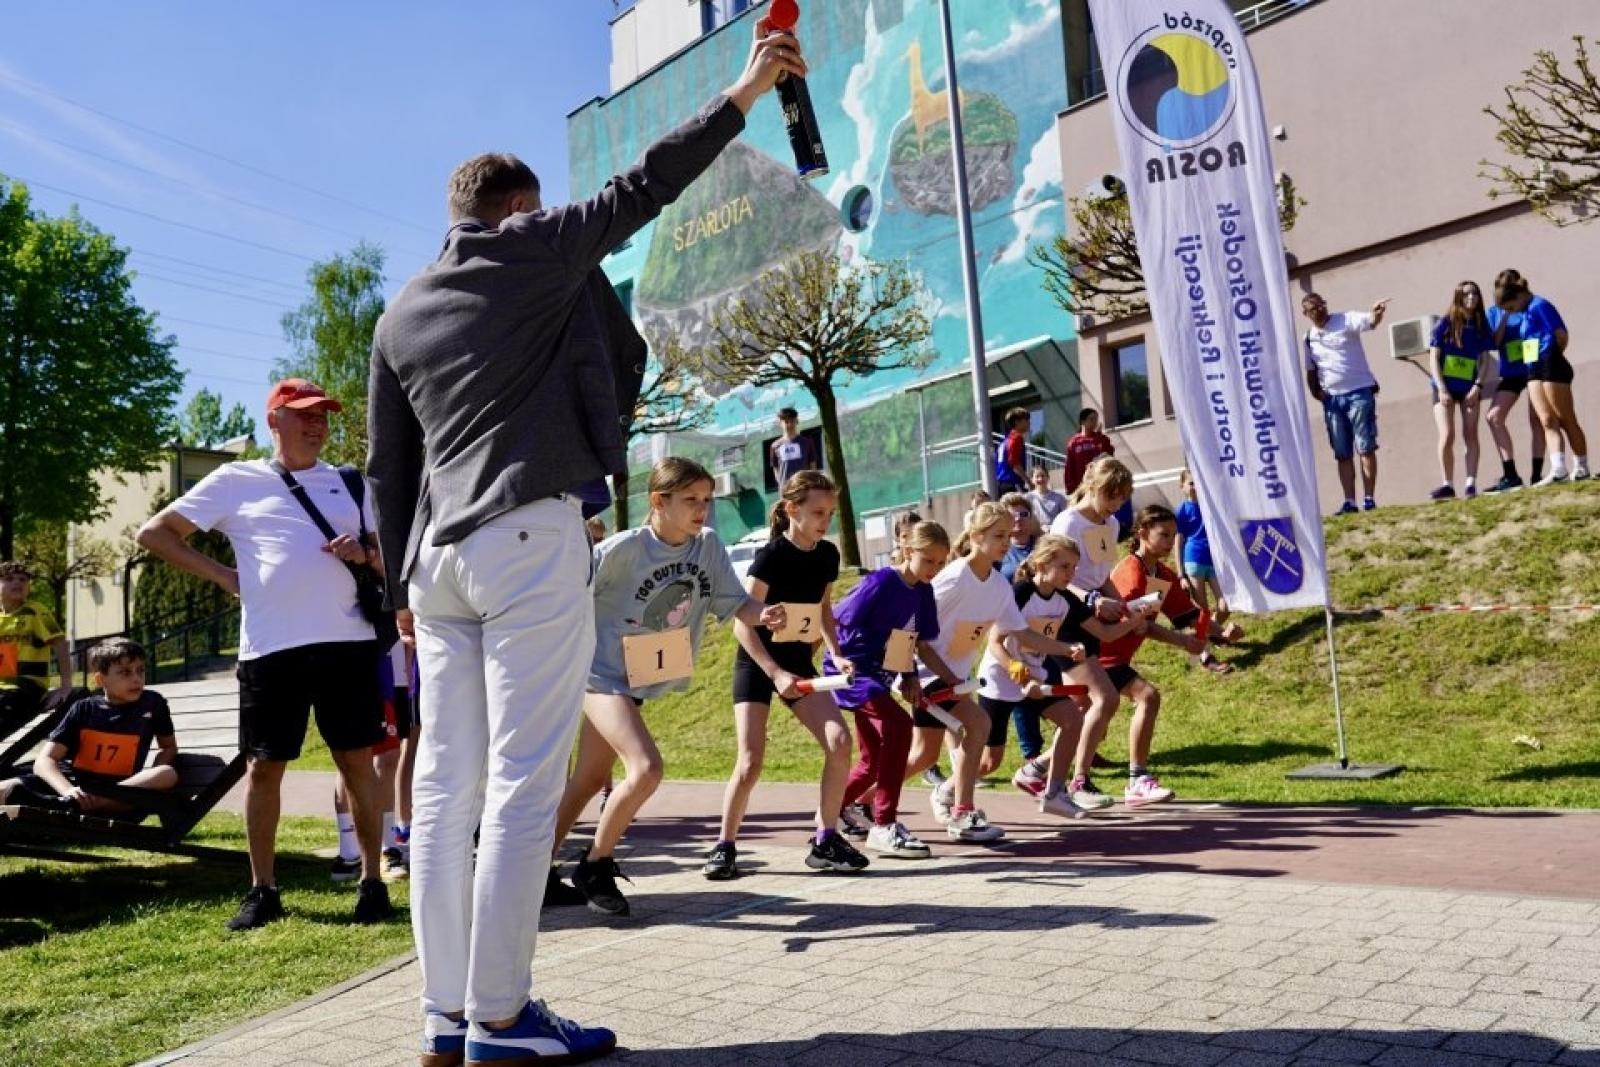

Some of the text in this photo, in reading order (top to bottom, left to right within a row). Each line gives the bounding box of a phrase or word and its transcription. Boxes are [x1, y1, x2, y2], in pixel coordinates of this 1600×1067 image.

[673, 195, 754, 252] SZARLOTA
[635, 578, 655, 601] TOO
[653, 562, 683, 582] CUTE
[686, 562, 699, 576] TO
[800, 616, 811, 635] 2
[656, 649, 664, 670] 1
[94, 744, 119, 763] 17
